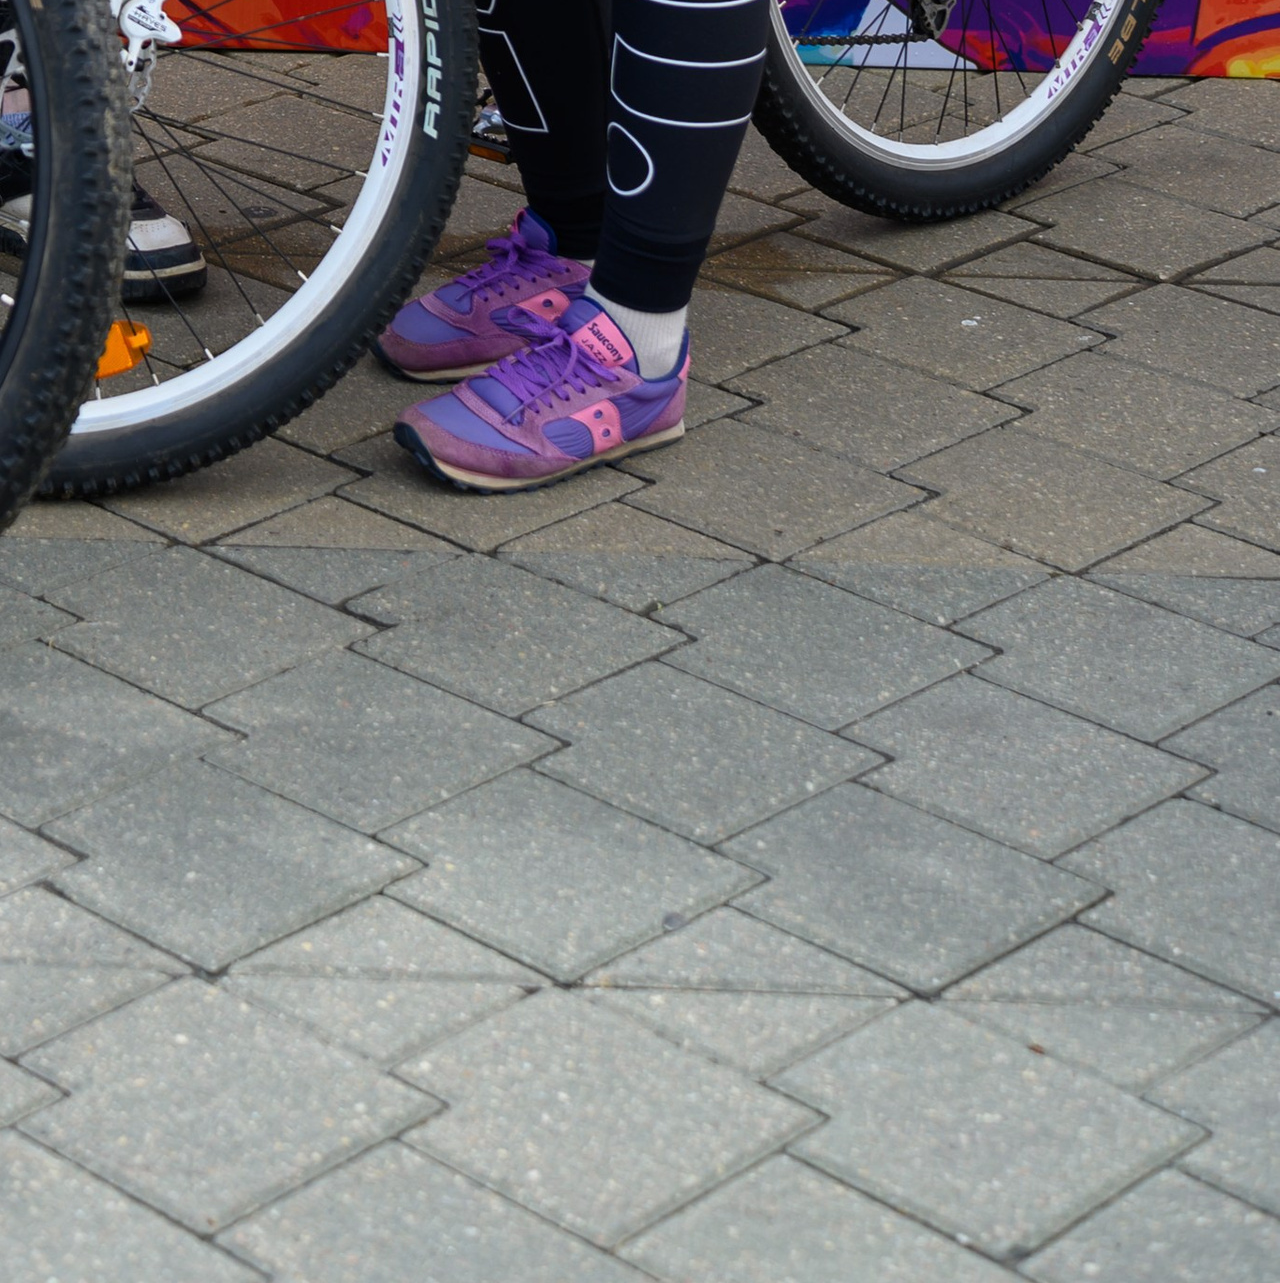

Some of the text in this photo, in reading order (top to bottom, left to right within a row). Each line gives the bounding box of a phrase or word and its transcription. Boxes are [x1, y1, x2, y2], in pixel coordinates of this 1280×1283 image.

[132, 9, 168, 33] HAYES
[581, 338, 608, 364] JAZZ
[587, 322, 624, 363] Saucony
